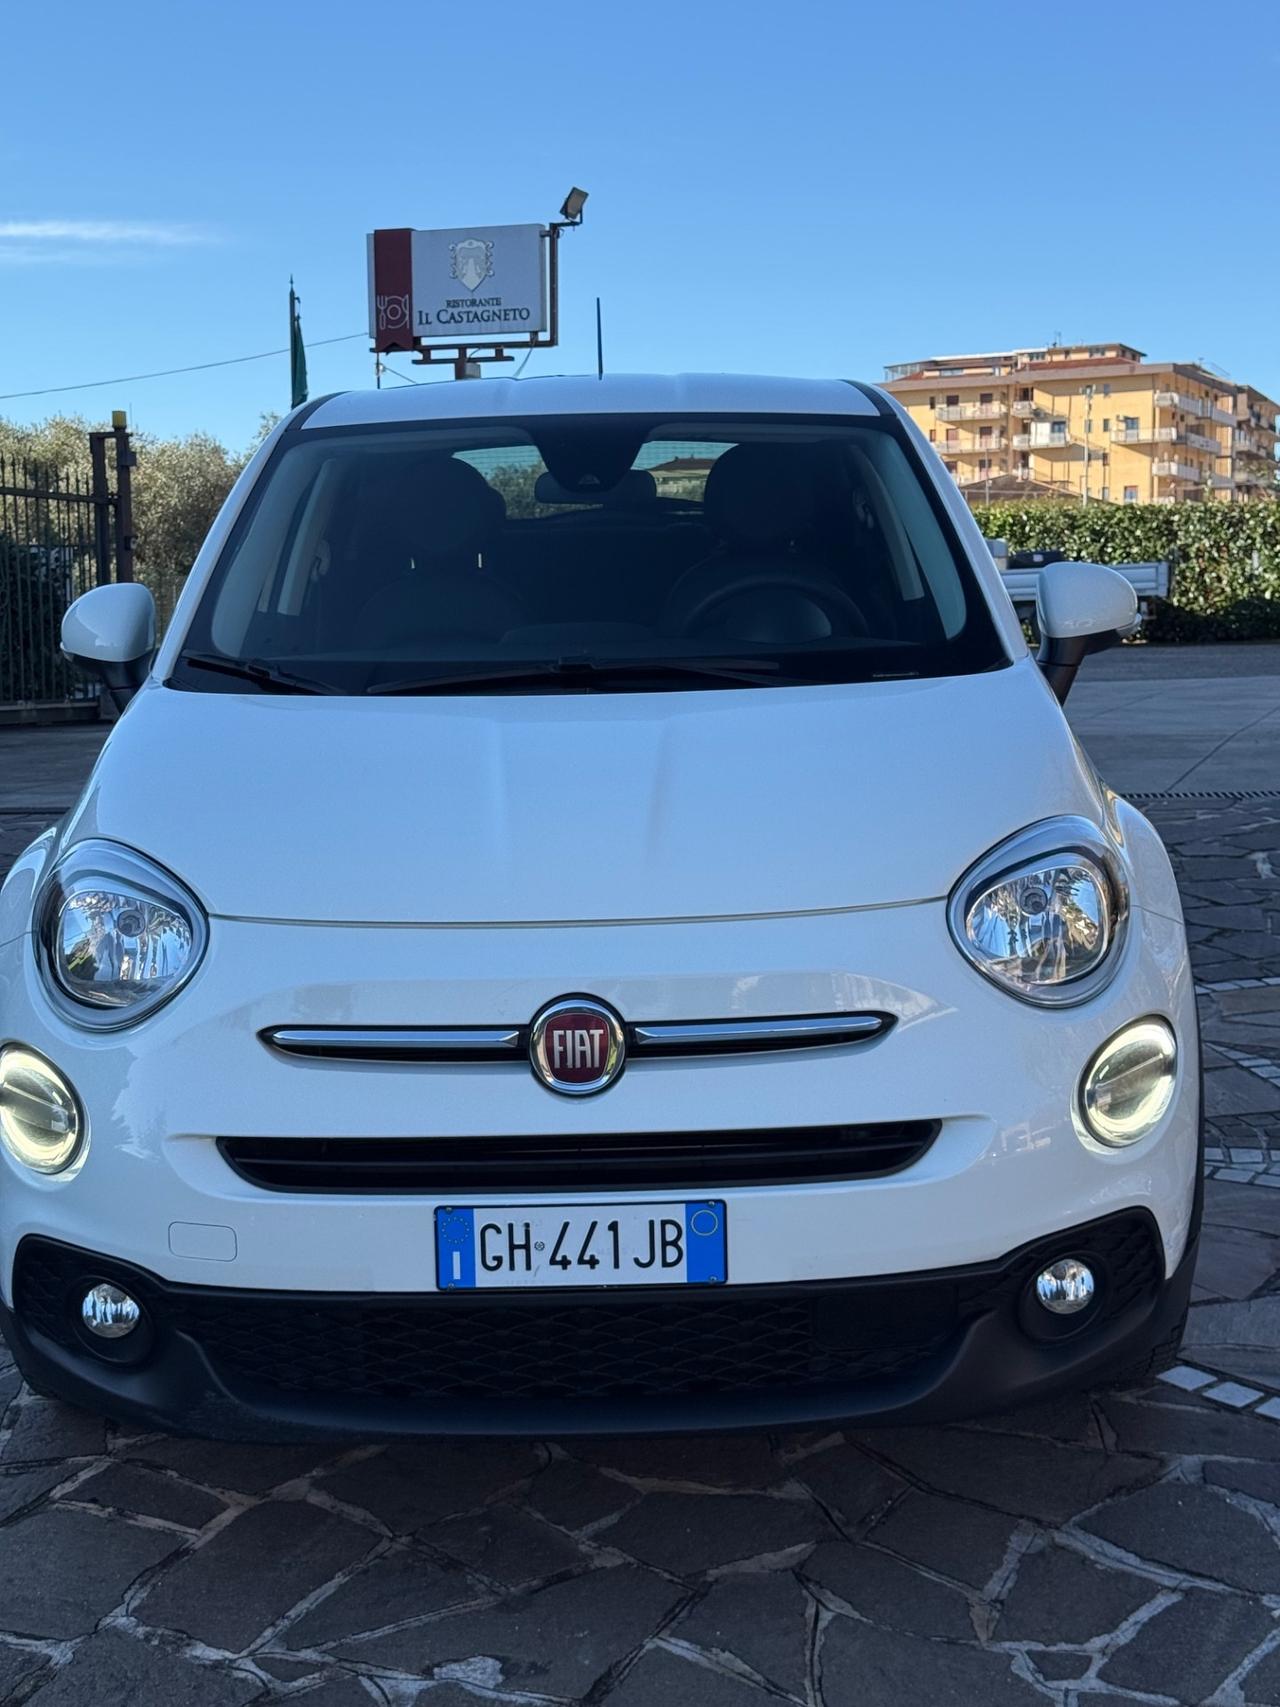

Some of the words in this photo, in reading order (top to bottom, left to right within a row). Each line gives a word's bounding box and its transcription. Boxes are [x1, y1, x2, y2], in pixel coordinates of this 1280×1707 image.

[446, 297, 502, 309] RISTORANTE
[436, 307, 530, 324] CASTAGNETO
[552, 1029, 604, 1069] FIAT
